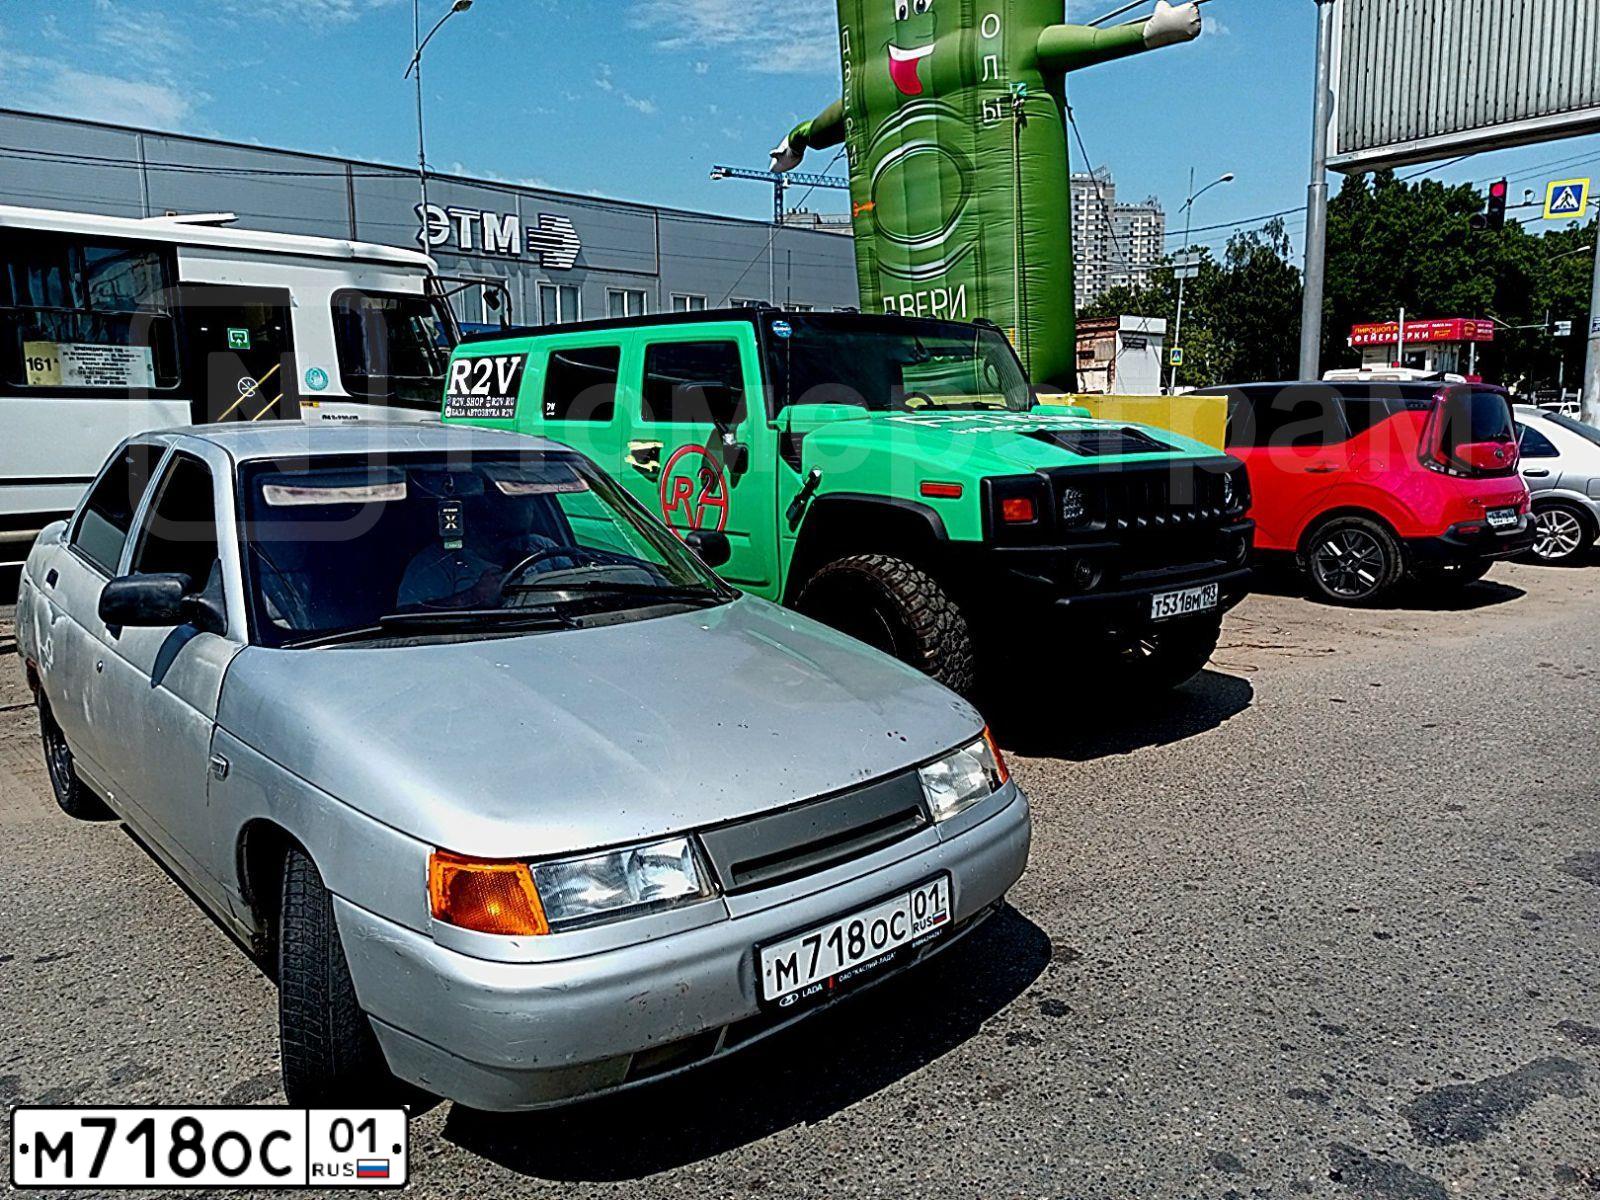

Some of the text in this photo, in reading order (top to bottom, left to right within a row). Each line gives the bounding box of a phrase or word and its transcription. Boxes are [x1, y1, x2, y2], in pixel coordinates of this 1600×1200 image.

[414, 203, 521, 255] ЭТМ
[883, 284, 967, 320] ДВЕРИ
[447, 356, 521, 396] R2V
[774, 883, 940, 992] М718ОС 01
[912, 916, 933, 935] RUS
[802, 983, 823, 998] LADA
